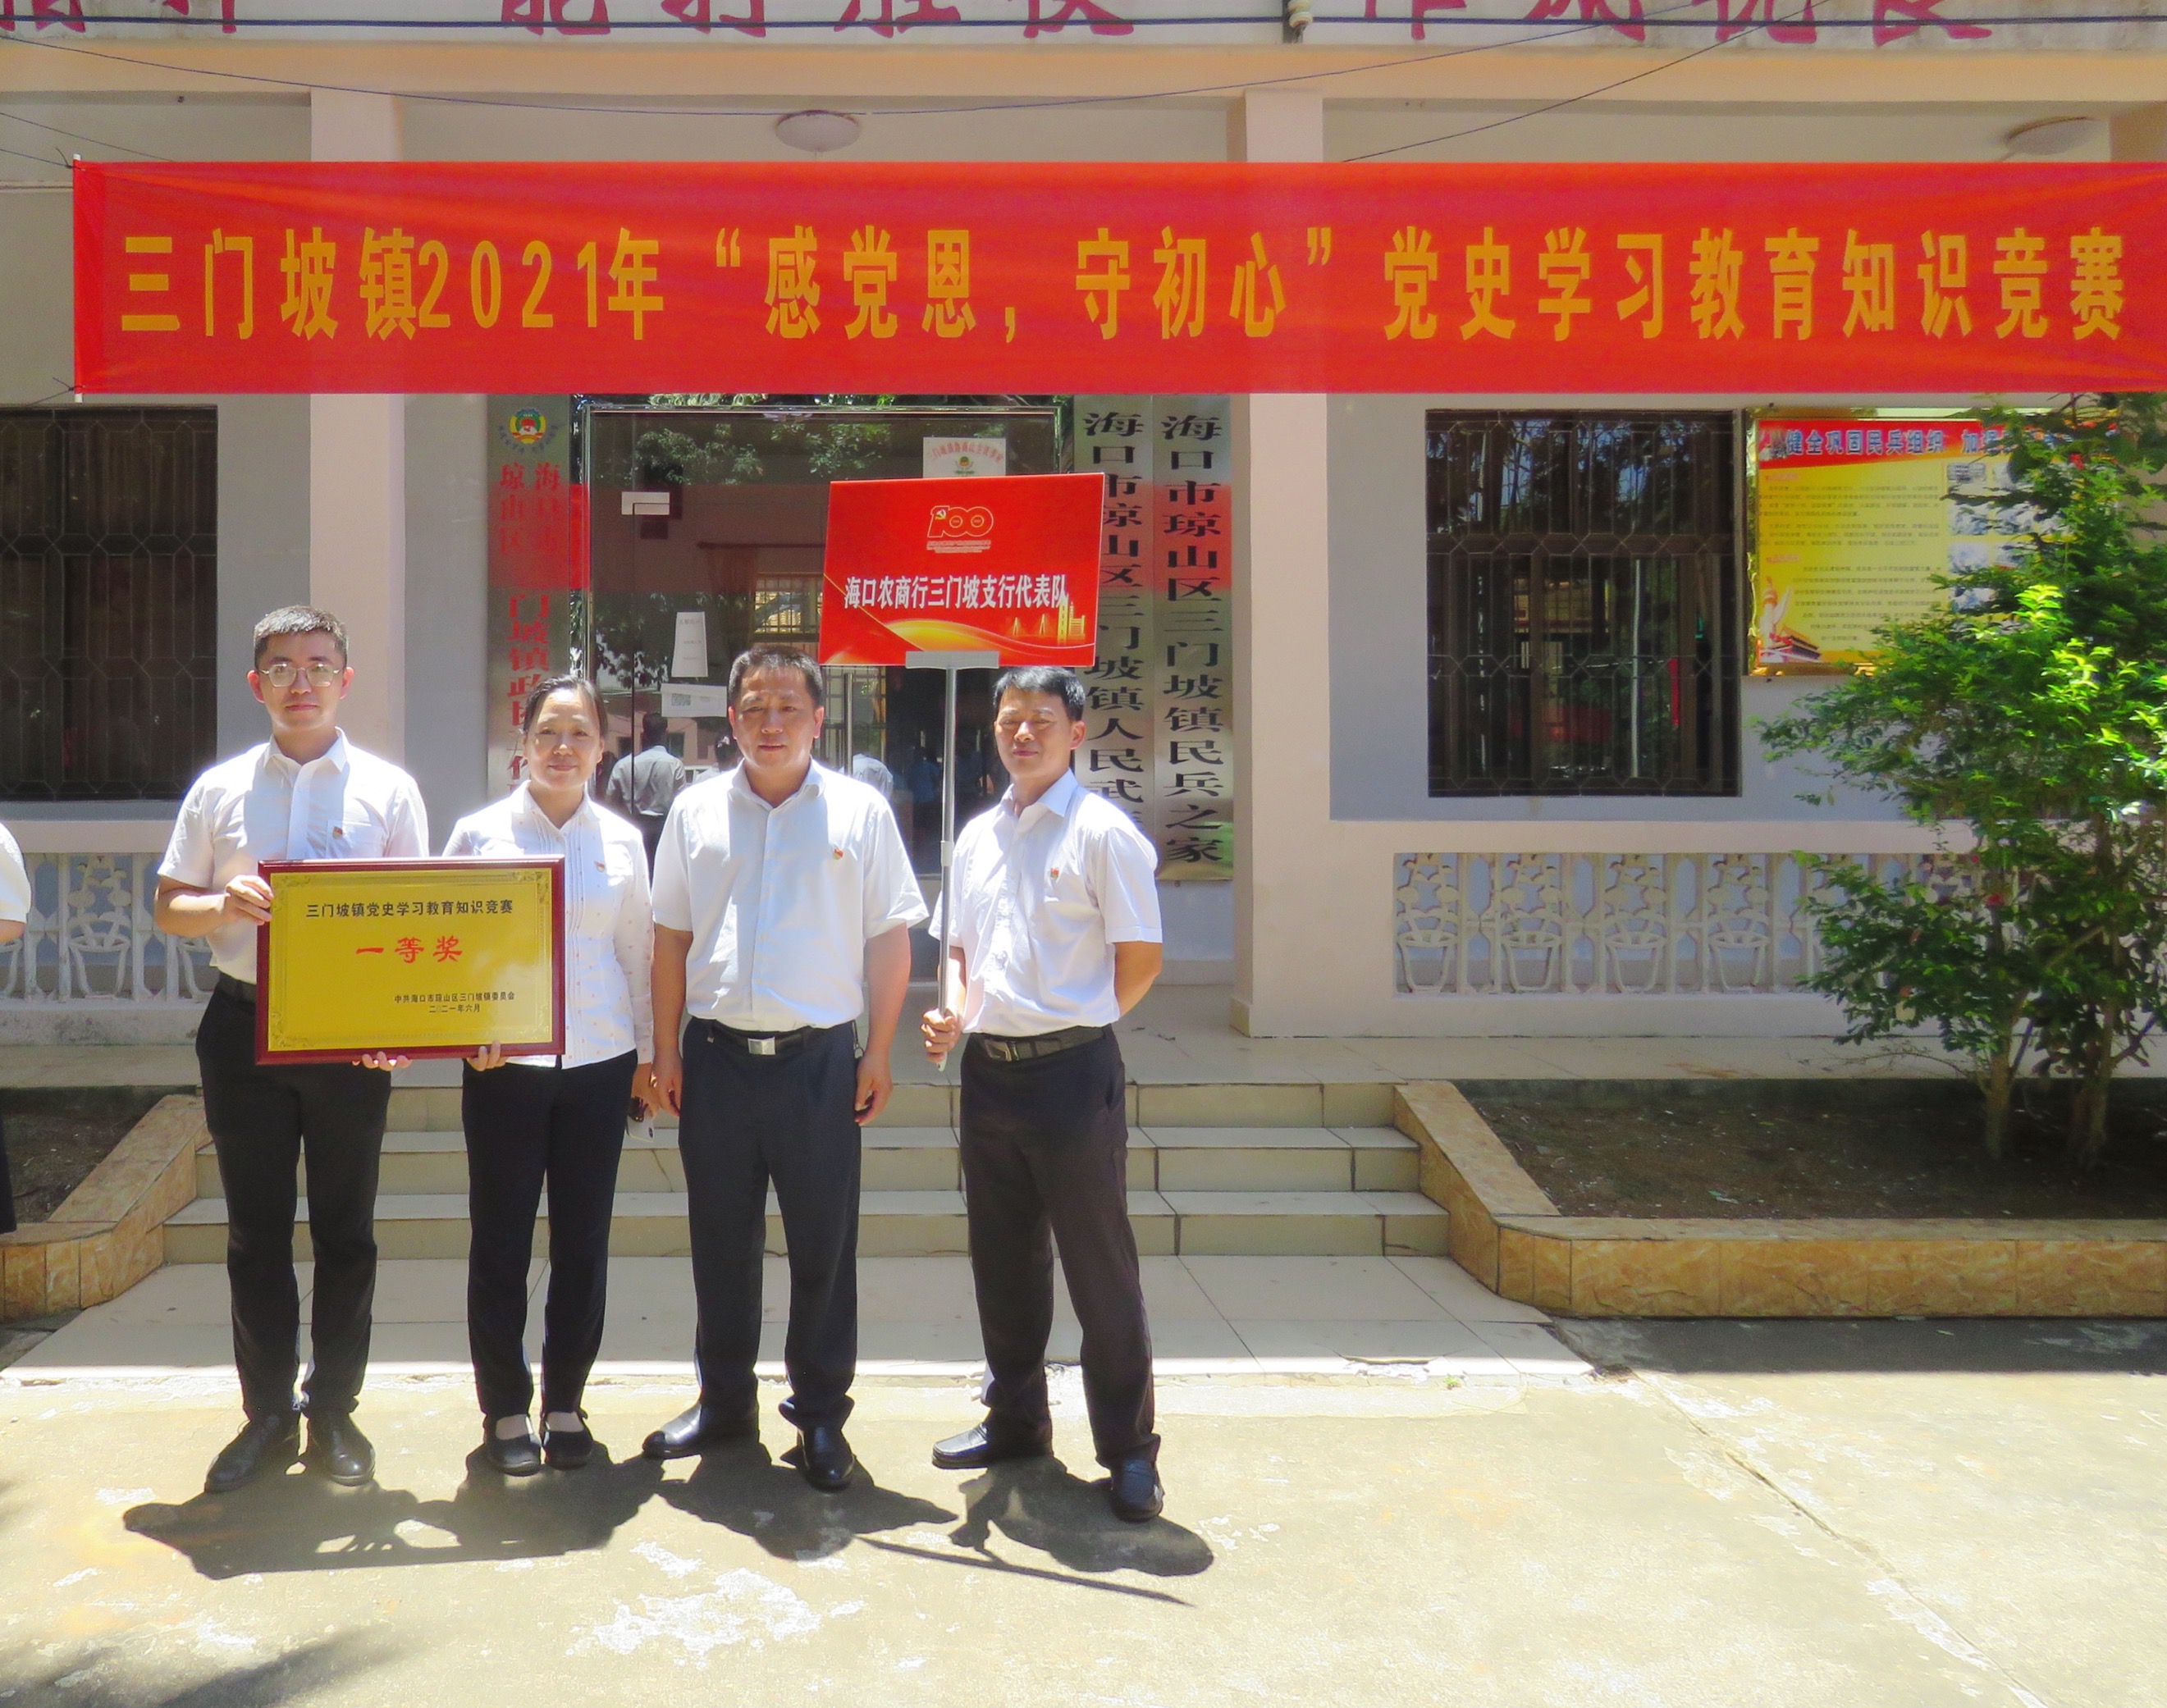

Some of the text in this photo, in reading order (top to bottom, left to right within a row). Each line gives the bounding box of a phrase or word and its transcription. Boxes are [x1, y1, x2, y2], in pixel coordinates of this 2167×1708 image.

[1785, 428, 1944, 456] 健全巩固民兵组织
[843, 573, 1070, 610] 海口农商行三门坡支行代表队
[1082, 412, 1145, 824] 海口市琼山区三门坡镇人民武
[1161, 414, 1224, 862] 海口市琼山区三门坡镇民兵之家
[305, 899, 514, 918] 三门坡镇党史学习教育知识竞赛
[355, 935, 464, 965] 一等奖
[394, 991, 515, 1004] 中共海口市琼山区三门坡镇委员会
